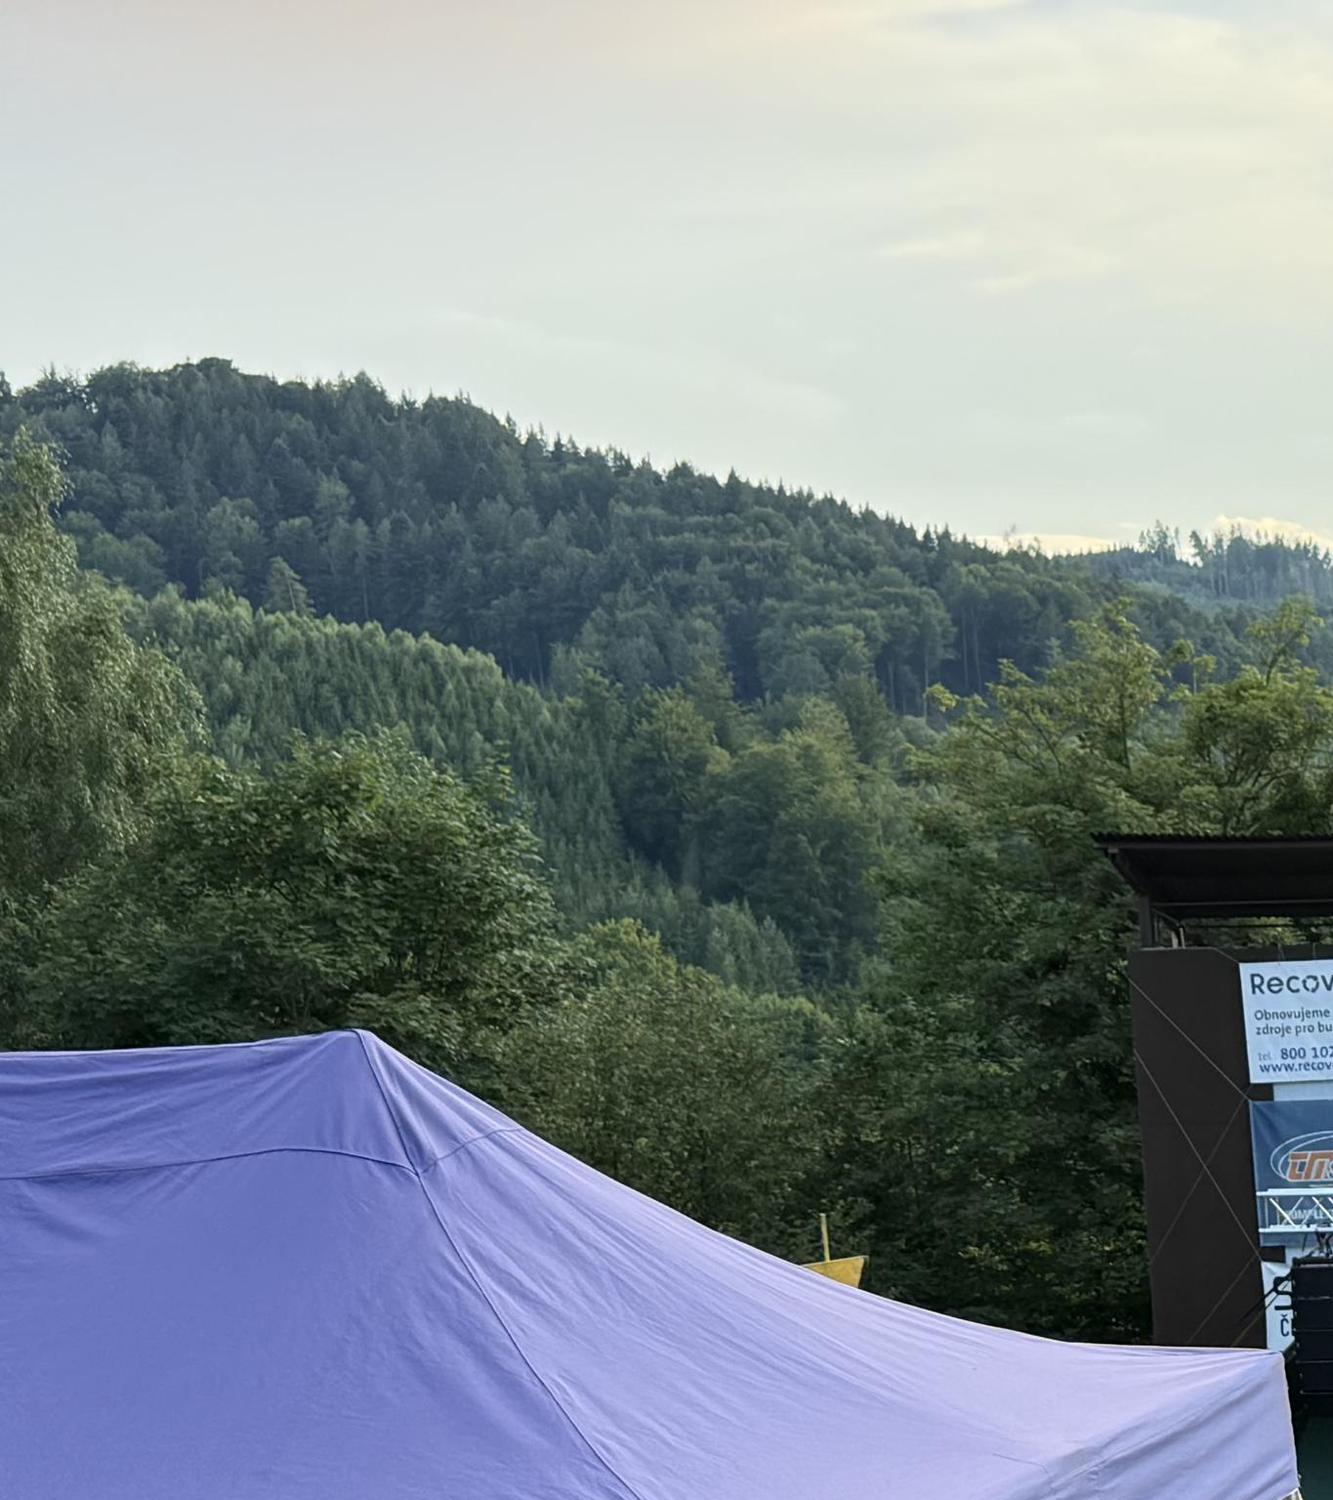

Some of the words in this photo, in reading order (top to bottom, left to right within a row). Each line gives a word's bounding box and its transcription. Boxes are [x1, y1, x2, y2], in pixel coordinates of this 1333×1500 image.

[1254, 1007, 1330, 1022] Obnovujeme
[1255, 1023, 1292, 1038] zdroje
[1295, 1024, 1315, 1036] pro
[1280, 1047, 1307, 1060] 800
